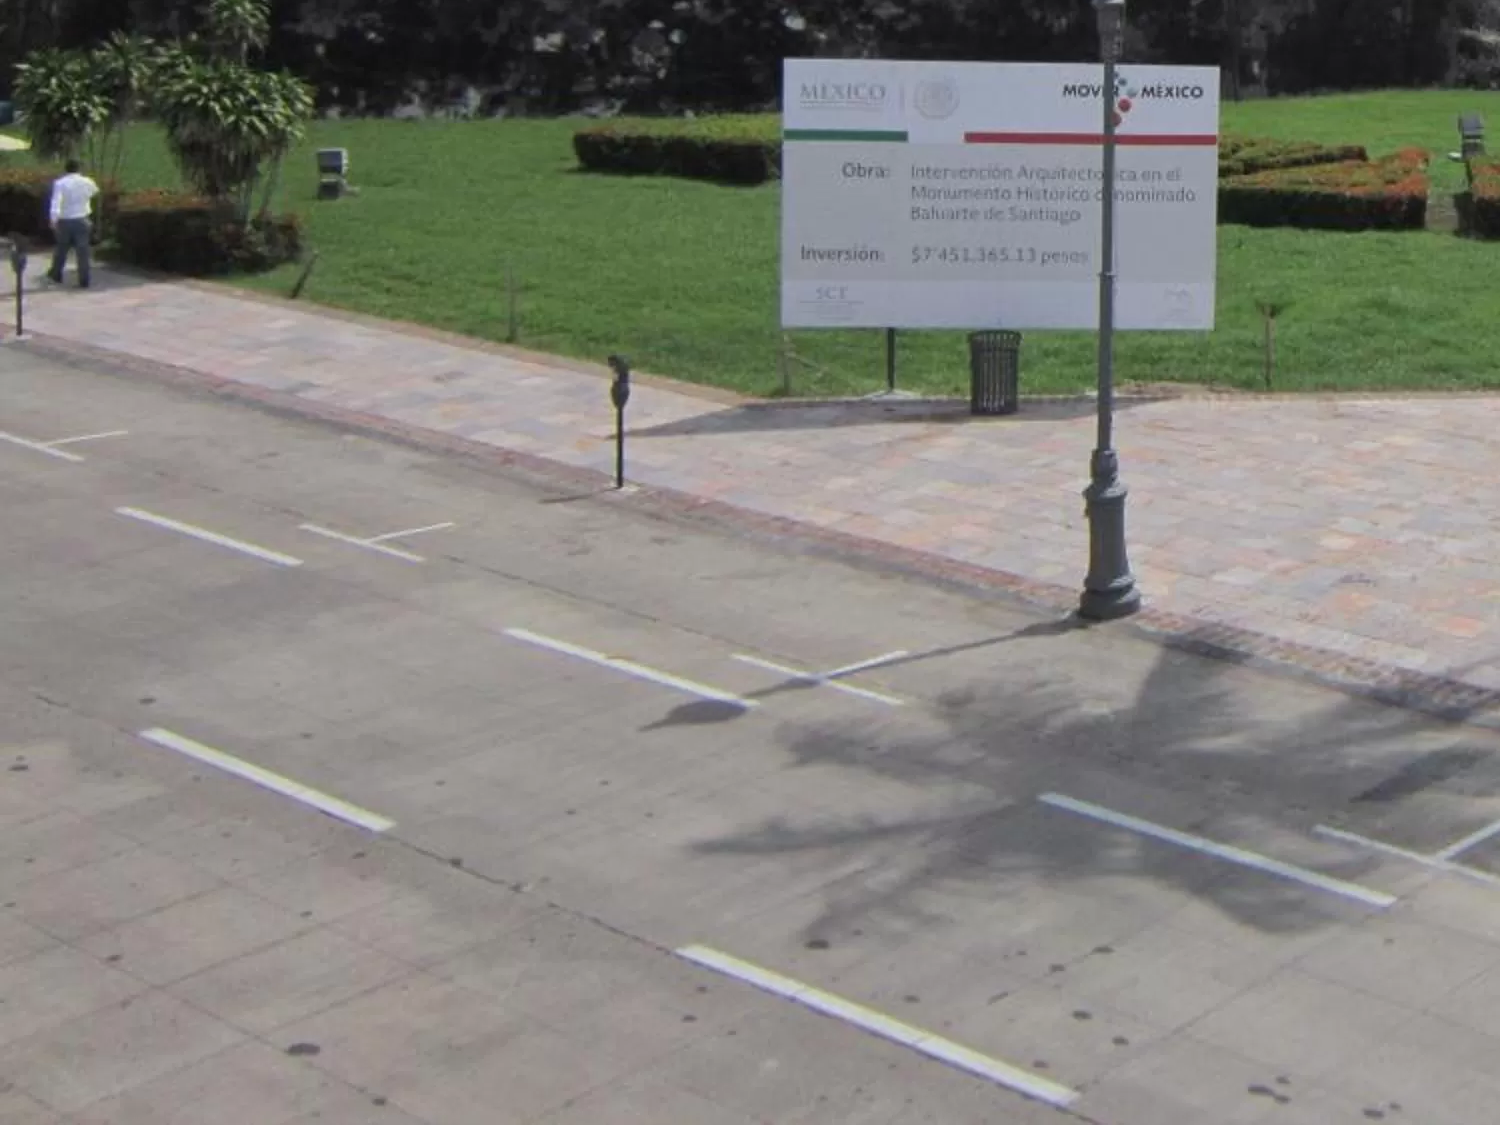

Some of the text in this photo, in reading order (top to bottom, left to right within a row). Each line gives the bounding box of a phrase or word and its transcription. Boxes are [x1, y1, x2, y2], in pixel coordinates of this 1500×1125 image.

[1062, 84, 1119, 98] MOVR
[841, 162, 889, 179] Obra:
[1141, 169, 1161, 182] en
[911, 185, 1011, 200] Monumento
[1095, 186, 1196, 203] dnominado
[911, 205, 1081, 225] Baluarte de Santiago
